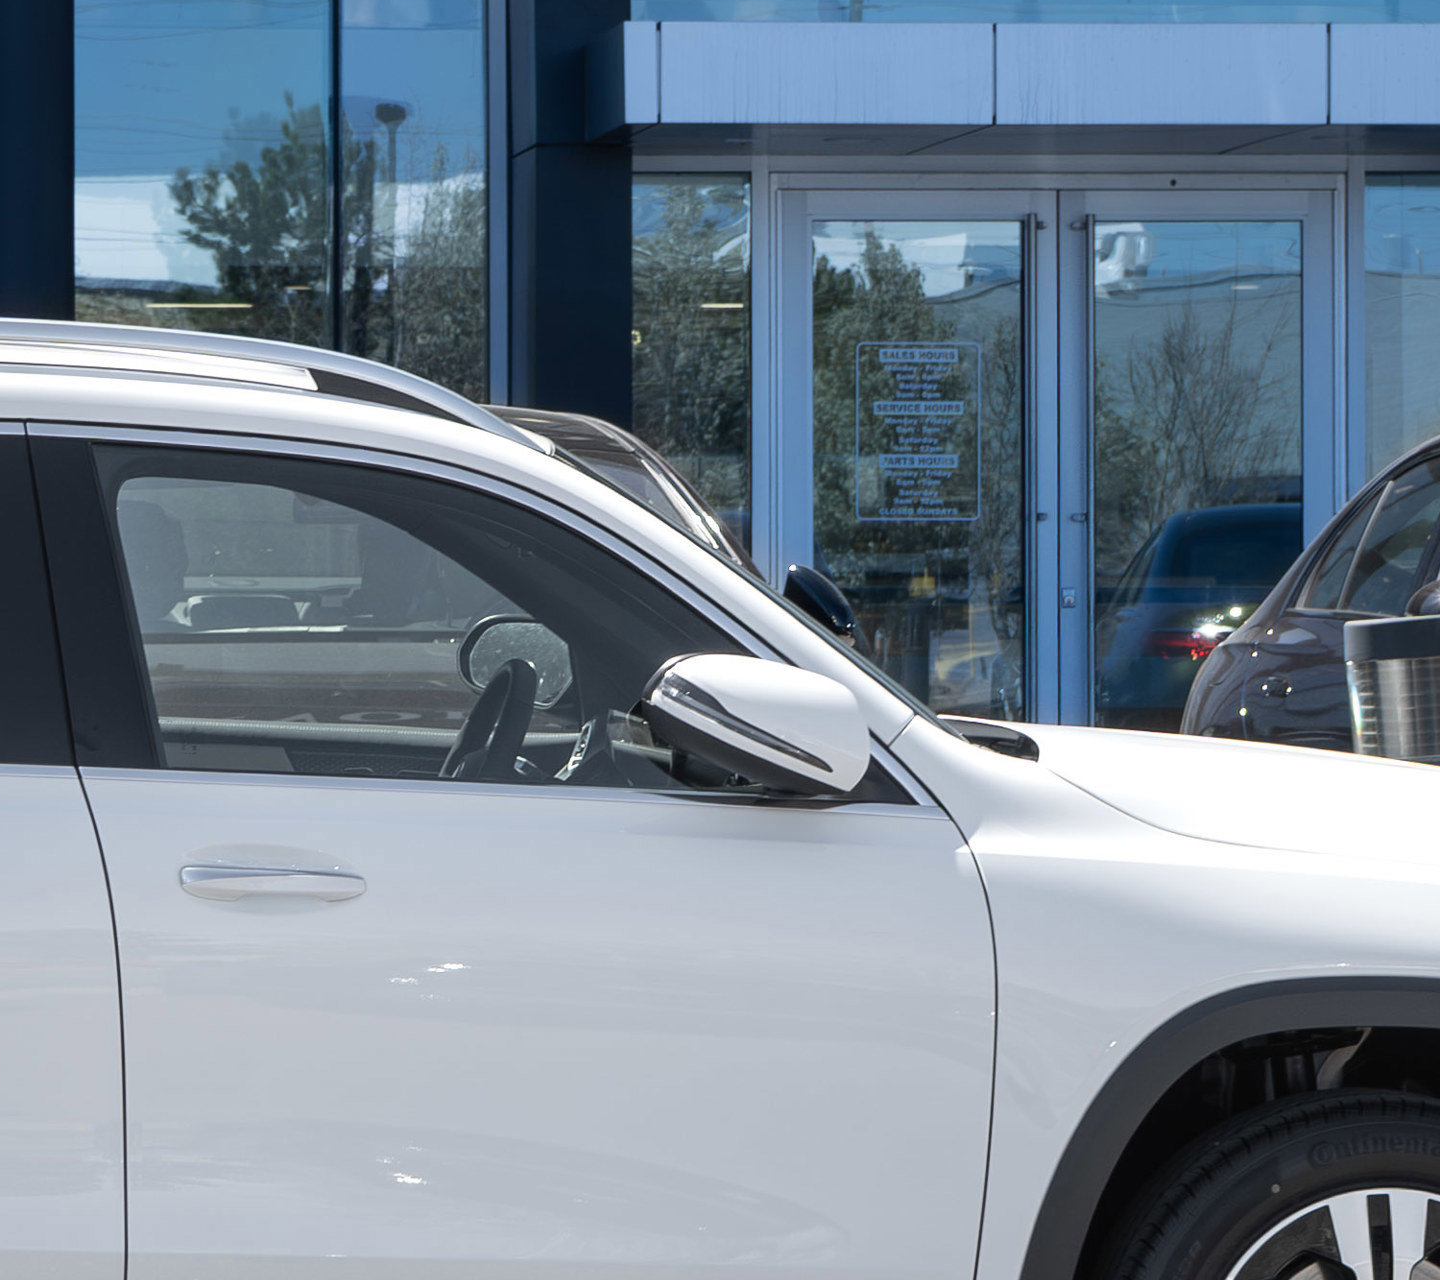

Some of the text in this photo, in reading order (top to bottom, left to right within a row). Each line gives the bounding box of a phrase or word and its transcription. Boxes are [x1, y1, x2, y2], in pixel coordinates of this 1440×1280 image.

[919, 351, 955, 360] HOURS
[877, 403, 960, 412] SERVICE HOURS
[919, 457, 955, 465] HOURS
[879, 508, 914, 516] CLOSED
